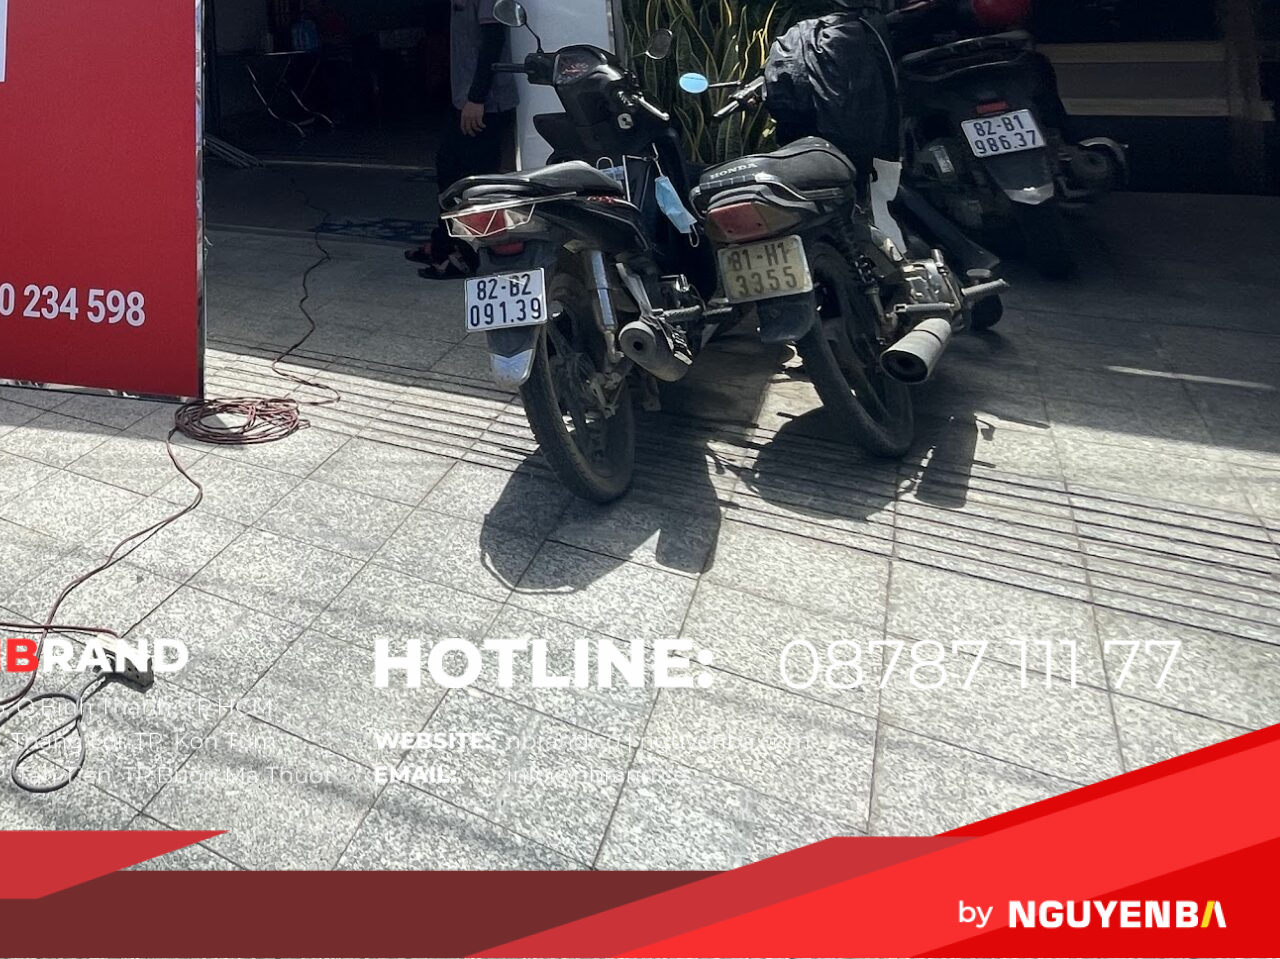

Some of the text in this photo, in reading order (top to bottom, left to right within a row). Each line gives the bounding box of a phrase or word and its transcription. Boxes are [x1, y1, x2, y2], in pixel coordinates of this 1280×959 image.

[973, 114, 1024, 137] 82-B1
[974, 129, 1037, 155] 986.37
[710, 162, 759, 181] HONDA
[476, 273, 532, 301] 82-B2
[735, 265, 798, 296] 3355
[23, 284, 79, 321] 234
[87, 288, 146, 327] 598
[470, 297, 542, 327] 091.39
